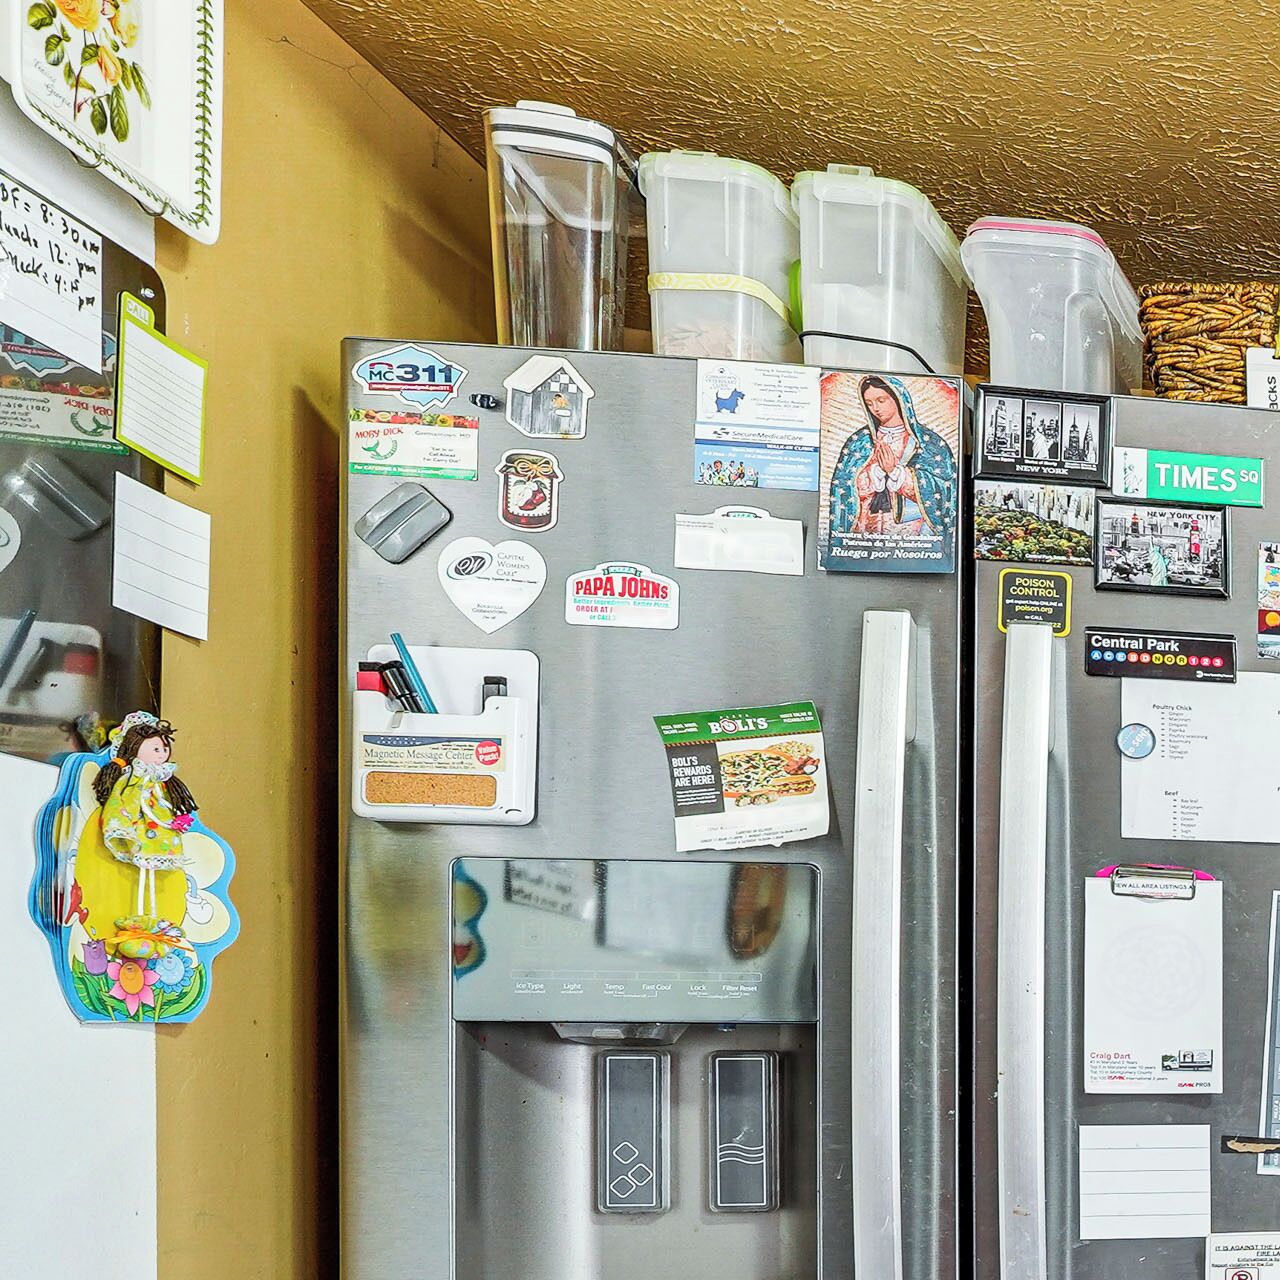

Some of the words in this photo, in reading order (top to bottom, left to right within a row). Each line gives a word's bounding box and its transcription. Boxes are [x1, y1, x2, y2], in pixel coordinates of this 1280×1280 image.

[127, 300, 149, 323] CALL
[369, 370, 394, 380] MC
[396, 364, 452, 382] 311
[1155, 463, 1237, 492] TIMES
[1240, 470, 1259, 483] SQ
[903, 533, 943, 542] Guadalupe
[831, 547, 869, 558] Ruega
[871, 550, 891, 560] por
[893, 550, 942, 559] Nosotros
[575, 577, 615, 595] PAPA
[618, 576, 668, 599] JOHNS
[1016, 578, 1054, 588] POISON
[1010, 587, 1059, 597] CONTROL
[1015, 605, 1053, 614] poison.org
[1092, 636, 1143, 650] Central
[1147, 639, 1180, 651] Park
[708, 718, 768, 734] BOLI'S
[364, 749, 404, 759] Magnetic
[406, 750, 444, 761] Message
[446, 750, 472, 760] Center
[672, 756, 698, 767] BOLI'S
[673, 765, 711, 777] REWARDS
[675, 777, 691, 787] ARE
[692, 775, 715, 785] HERE!
[527, 983, 545, 991] Type
[564, 983, 581, 991] Light
[605, 983, 624, 991] Temp
[1090, 1052, 1112, 1060] Craig
